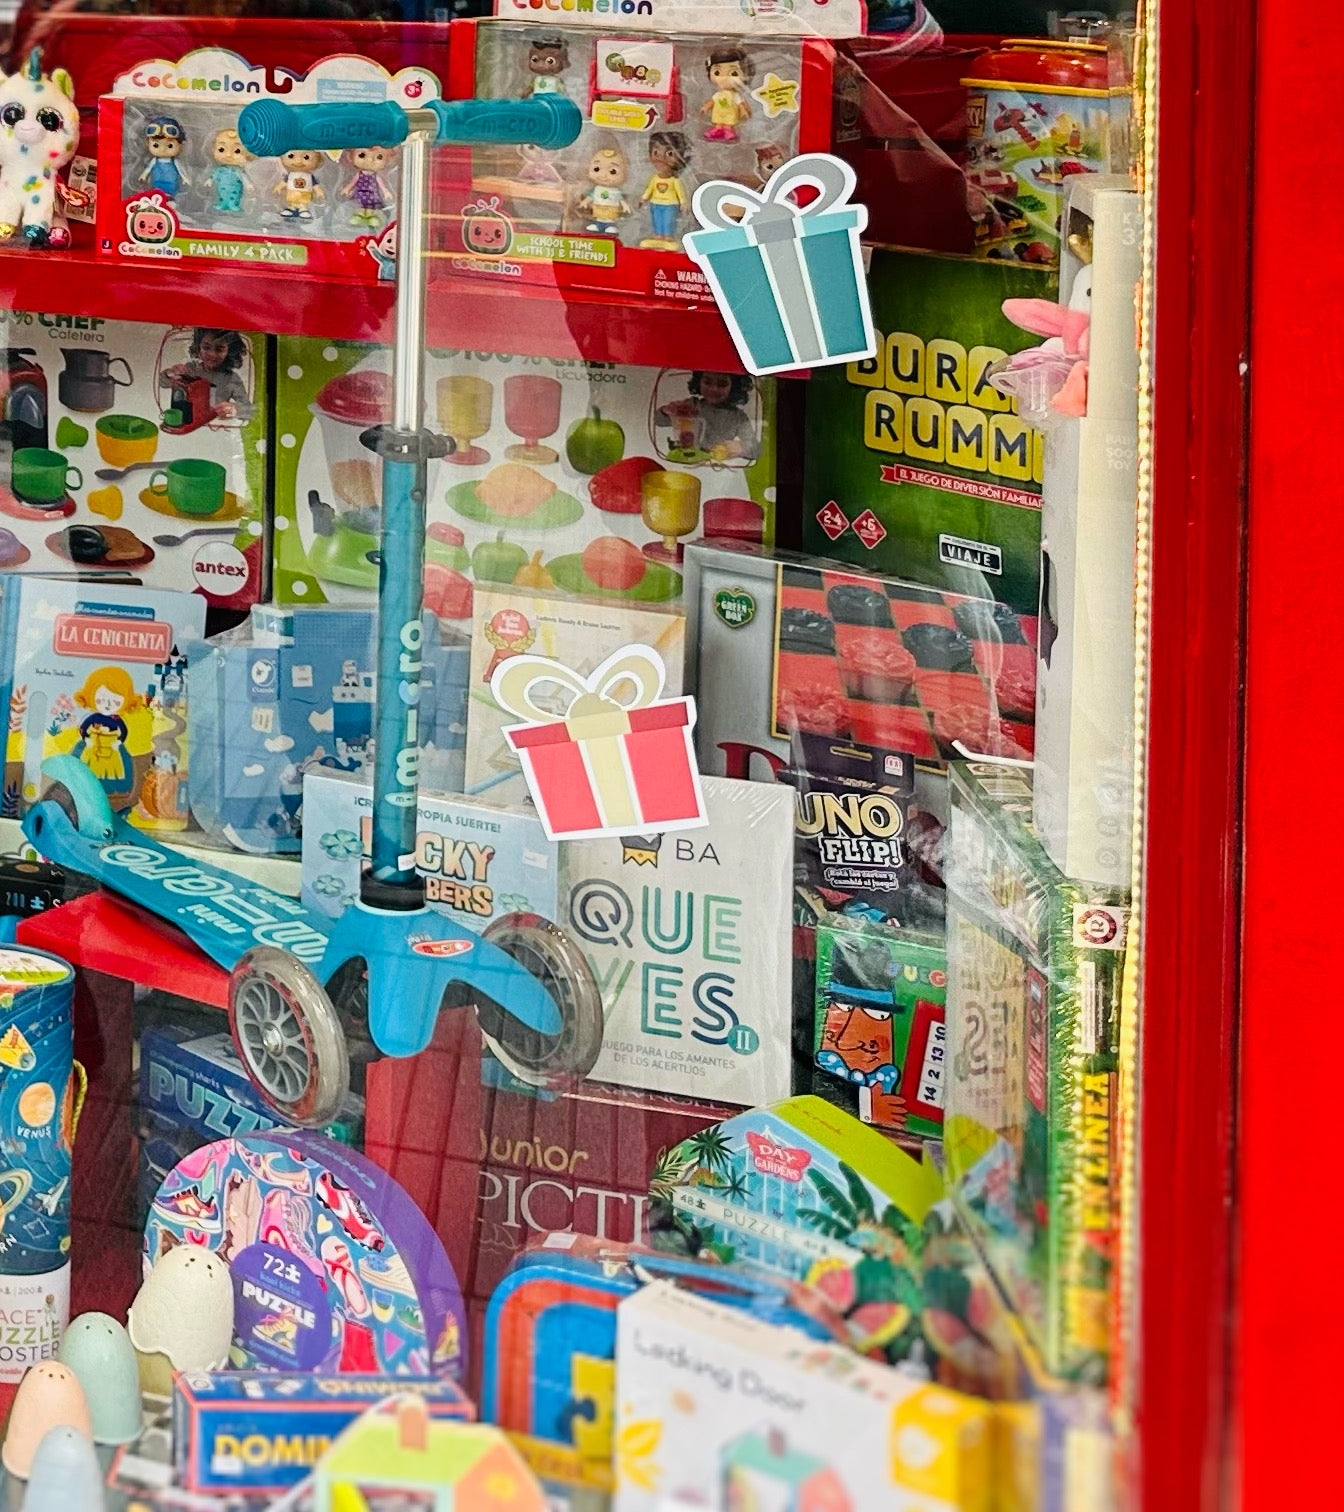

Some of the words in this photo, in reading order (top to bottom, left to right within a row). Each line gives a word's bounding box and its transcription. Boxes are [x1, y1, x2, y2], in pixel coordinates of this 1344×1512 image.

[189, 243, 241, 256] FAMILY
[245, 246, 255, 257] 4
[260, 247, 294, 261] PACK
[517, 245, 543, 255] WITH
[569, 249, 608, 262] FRIENDS
[530, 238, 565, 249] SCHOOL
[569, 239, 593, 250] TIME
[556, 368, 627, 385] Licuadora
[899, 469, 909, 480] EL
[910, 471, 940, 485] JUEGO
[941, 478, 953, 488] DE
[954, 480, 1001, 499] DIVERSIÓN
[947, 545, 991, 567] VIAJE
[195, 560, 246, 578] antex
[61, 625, 79, 643] LA
[83, 627, 166, 651] CENICIENTA
[418, 809, 452, 825] ROPIA
[456, 816, 501, 833] SUERTE!
[795, 793, 902, 839] UNO
[677, 840, 721, 866] BA
[823, 839, 901, 864] FLIP!
[426, 876, 493, 918] BERS
[178, 904, 246, 934] mini
[570, 878, 742, 964] QUE
[936, 1026, 946, 1041] 10
[614, 1052, 629, 1065] DE
[632, 1054, 650, 1069] LOS
[651, 1058, 706, 1077] ACERTIJOS
[636, 1045, 662, 1060] PARA
[665, 1049, 684, 1064] LOS
[686, 1052, 736, 1070] AMANTES
[931, 1046, 944, 1062] 13
[928, 1071, 940, 1080] 2
[148, 1061, 274, 1138] PUZZ
[924, 1086, 936, 1102] 14
[17, 1126, 52, 1139] VENUS
[759, 1145, 796, 1164] DAY
[755, 1158, 800, 1180] GARDENS
[479, 1171, 650, 1248] PICTI
[681, 1194, 694, 1206] 48
[264, 1252, 284, 1278] 72
[242, 1280, 316, 1329] PUZZLE
[633, 1329, 732, 1393] Locking
[739, 1369, 807, 1415] Door
